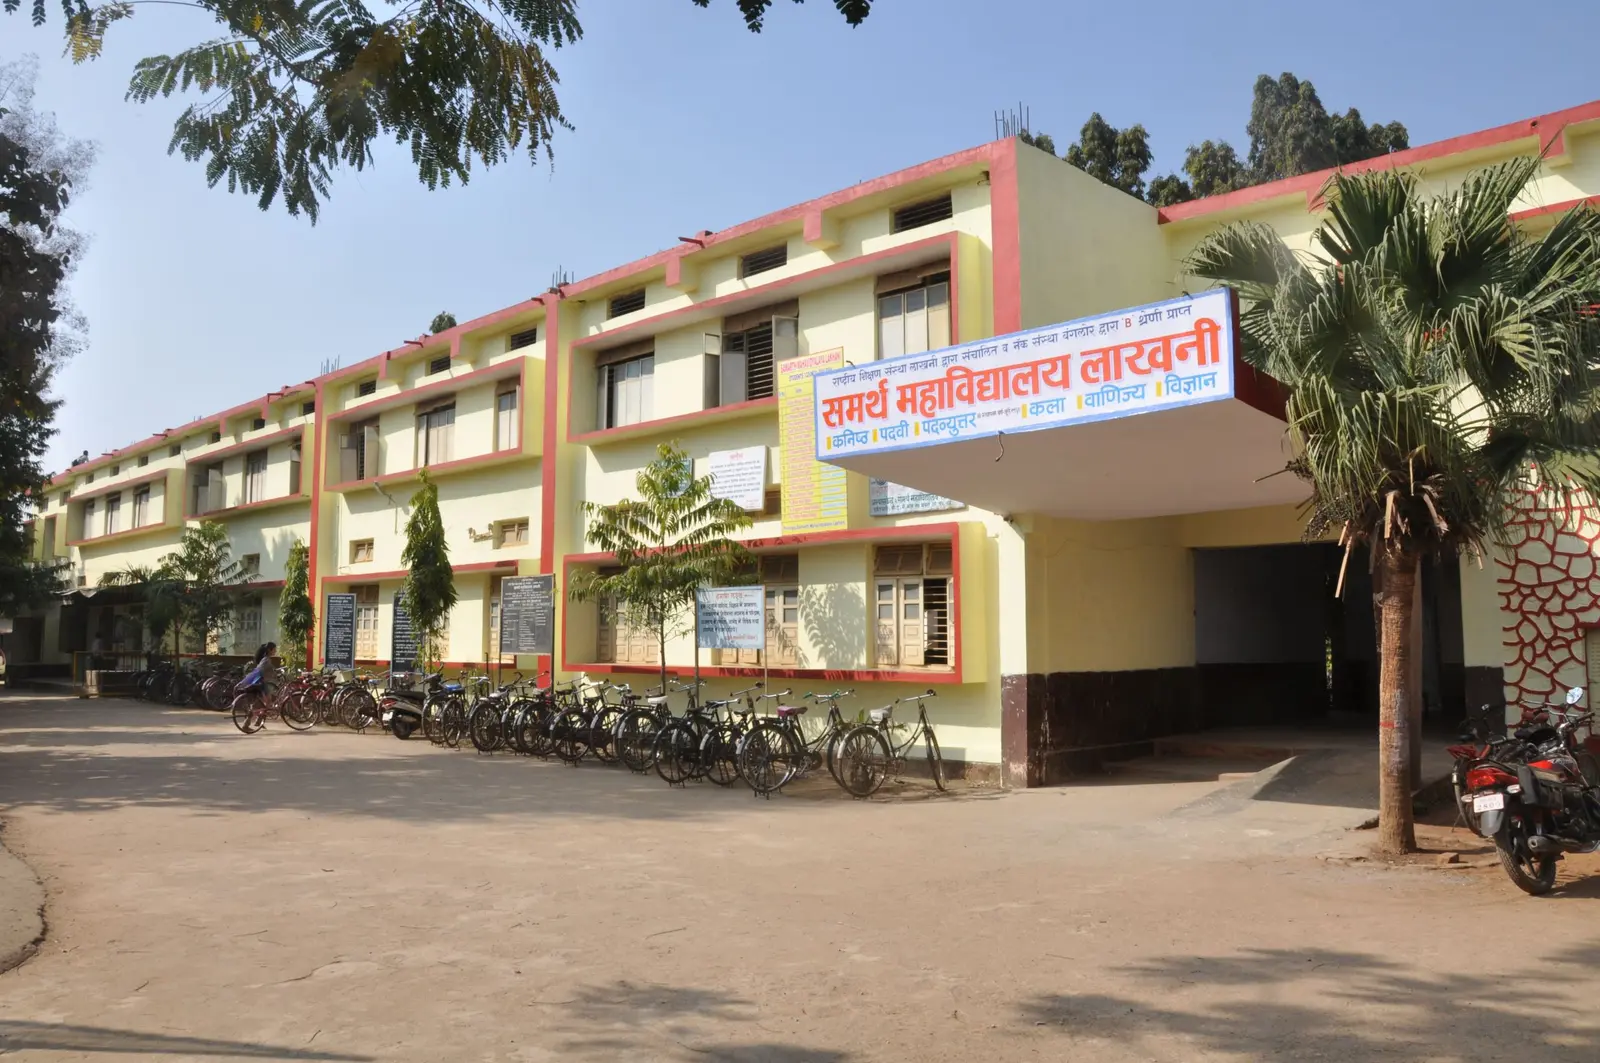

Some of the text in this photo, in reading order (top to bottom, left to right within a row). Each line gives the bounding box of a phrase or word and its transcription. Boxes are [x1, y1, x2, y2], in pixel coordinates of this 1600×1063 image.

[822, 377, 889, 428] समर्थ
[895, 353, 1072, 419] महाविद्यालय
[1080, 317, 1222, 385] लाखनी
[832, 372, 857, 387] राष्ट्रीय
[859, 368, 881, 382] शिक्षण
[884, 363, 907, 377] संस्था
[909, 354, 938, 372] लाखनी
[941, 353, 958, 368] द्वारा
[961, 344, 998, 361] संचालित
[1002, 343, 1009, 353] व
[1032, 333, 1058, 347] संस्था
[1099, 320, 1119, 335] द्वारा
[1138, 309, 1163, 326] श्रेणी
[1167, 304, 1192, 320] प्राप्त
[832, 428, 869, 448] कनिष्ठ
[879, 420, 909, 441] पदवी
[922, 412, 976, 436] पदव्युत्तर
[1029, 397, 1066, 416] कला
[1084, 383, 1146, 407] वाणिज्य
[1165, 372, 1217, 395] विज्ञान
